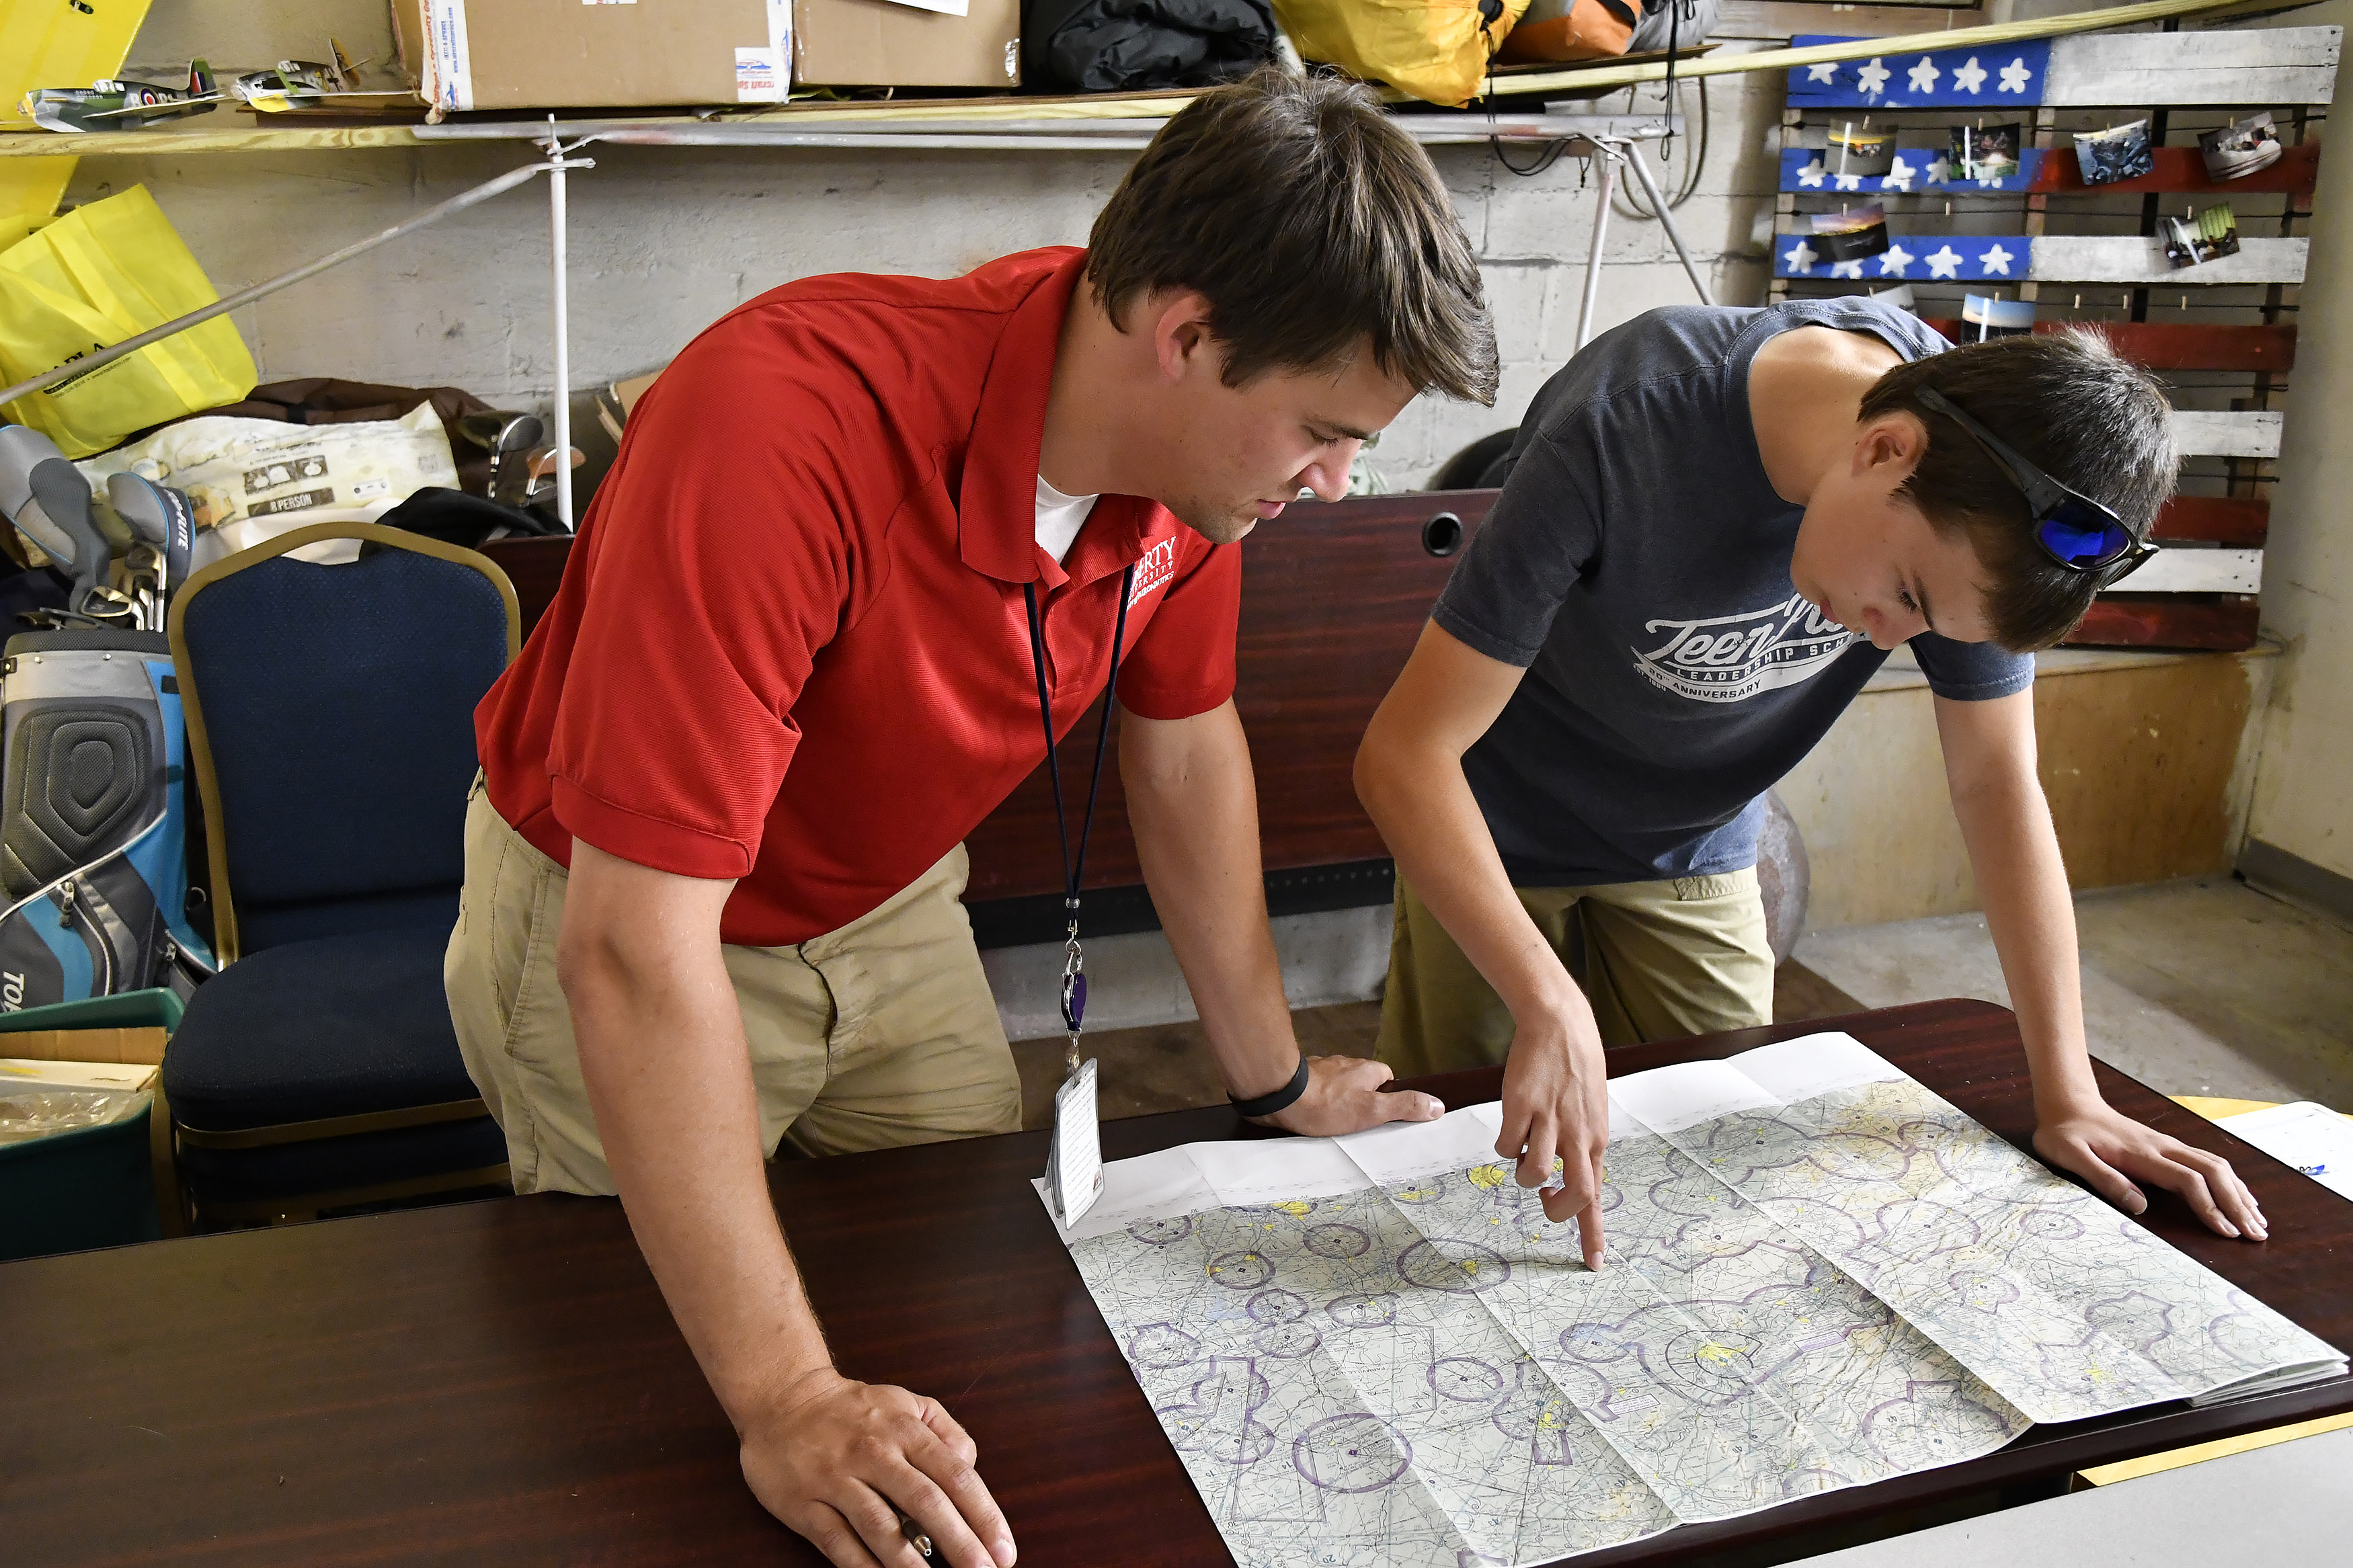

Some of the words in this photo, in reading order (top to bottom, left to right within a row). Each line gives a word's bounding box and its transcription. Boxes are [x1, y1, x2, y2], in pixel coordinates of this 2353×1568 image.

[278, 493, 313, 511] PERSON
[1677, 648, 1794, 682] LEADERSHIP
[1673, 679, 1761, 698] ANNIVERSARY
